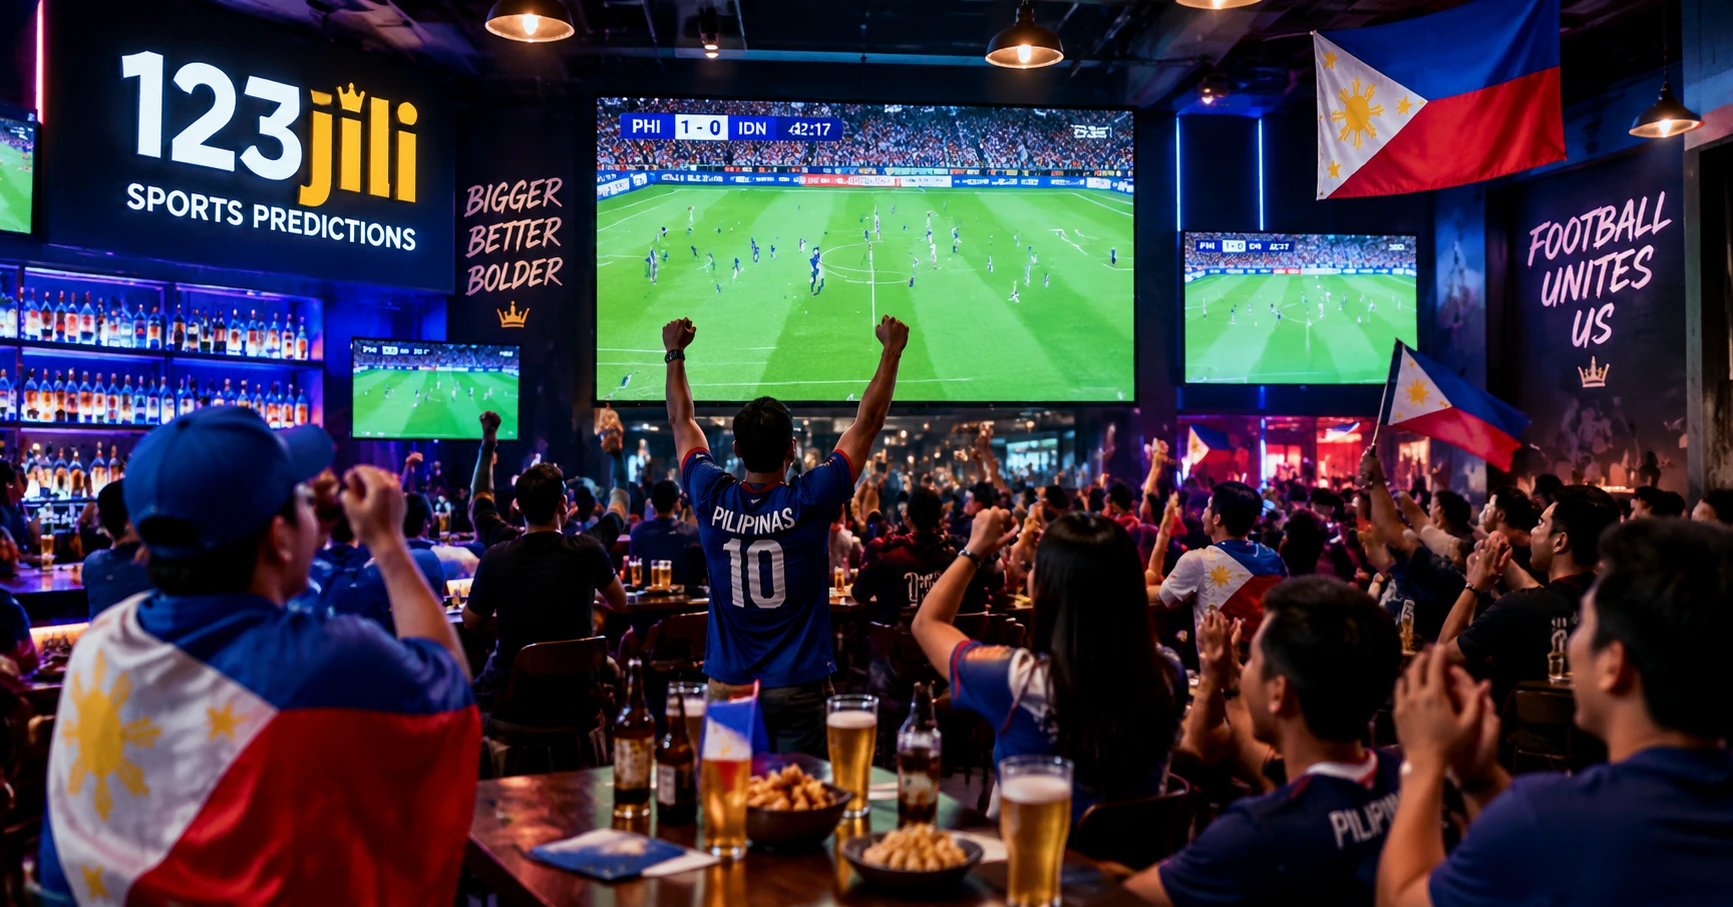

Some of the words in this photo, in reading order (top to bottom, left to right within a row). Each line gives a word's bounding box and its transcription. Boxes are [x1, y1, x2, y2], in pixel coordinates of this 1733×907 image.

[632, 119, 661, 134] PHI
[680, 120, 690, 134] 1
[709, 119, 721, 136] 0
[738, 121, 767, 136] IDN
[127, 183, 244, 225] SPORTS
[253, 204, 416, 251] PREDICTIONS
[465, 177, 563, 217] BIGGER
[466, 217, 563, 258] BETTER
[1528, 191, 1672, 267] FOOTBALL
[466, 257, 564, 297] BOLDER
[1540, 244, 1655, 308] UNITES
[1572, 302, 1615, 348] US
[711, 505, 796, 535] PILIPINAS
[722, 538, 787, 610] 10
